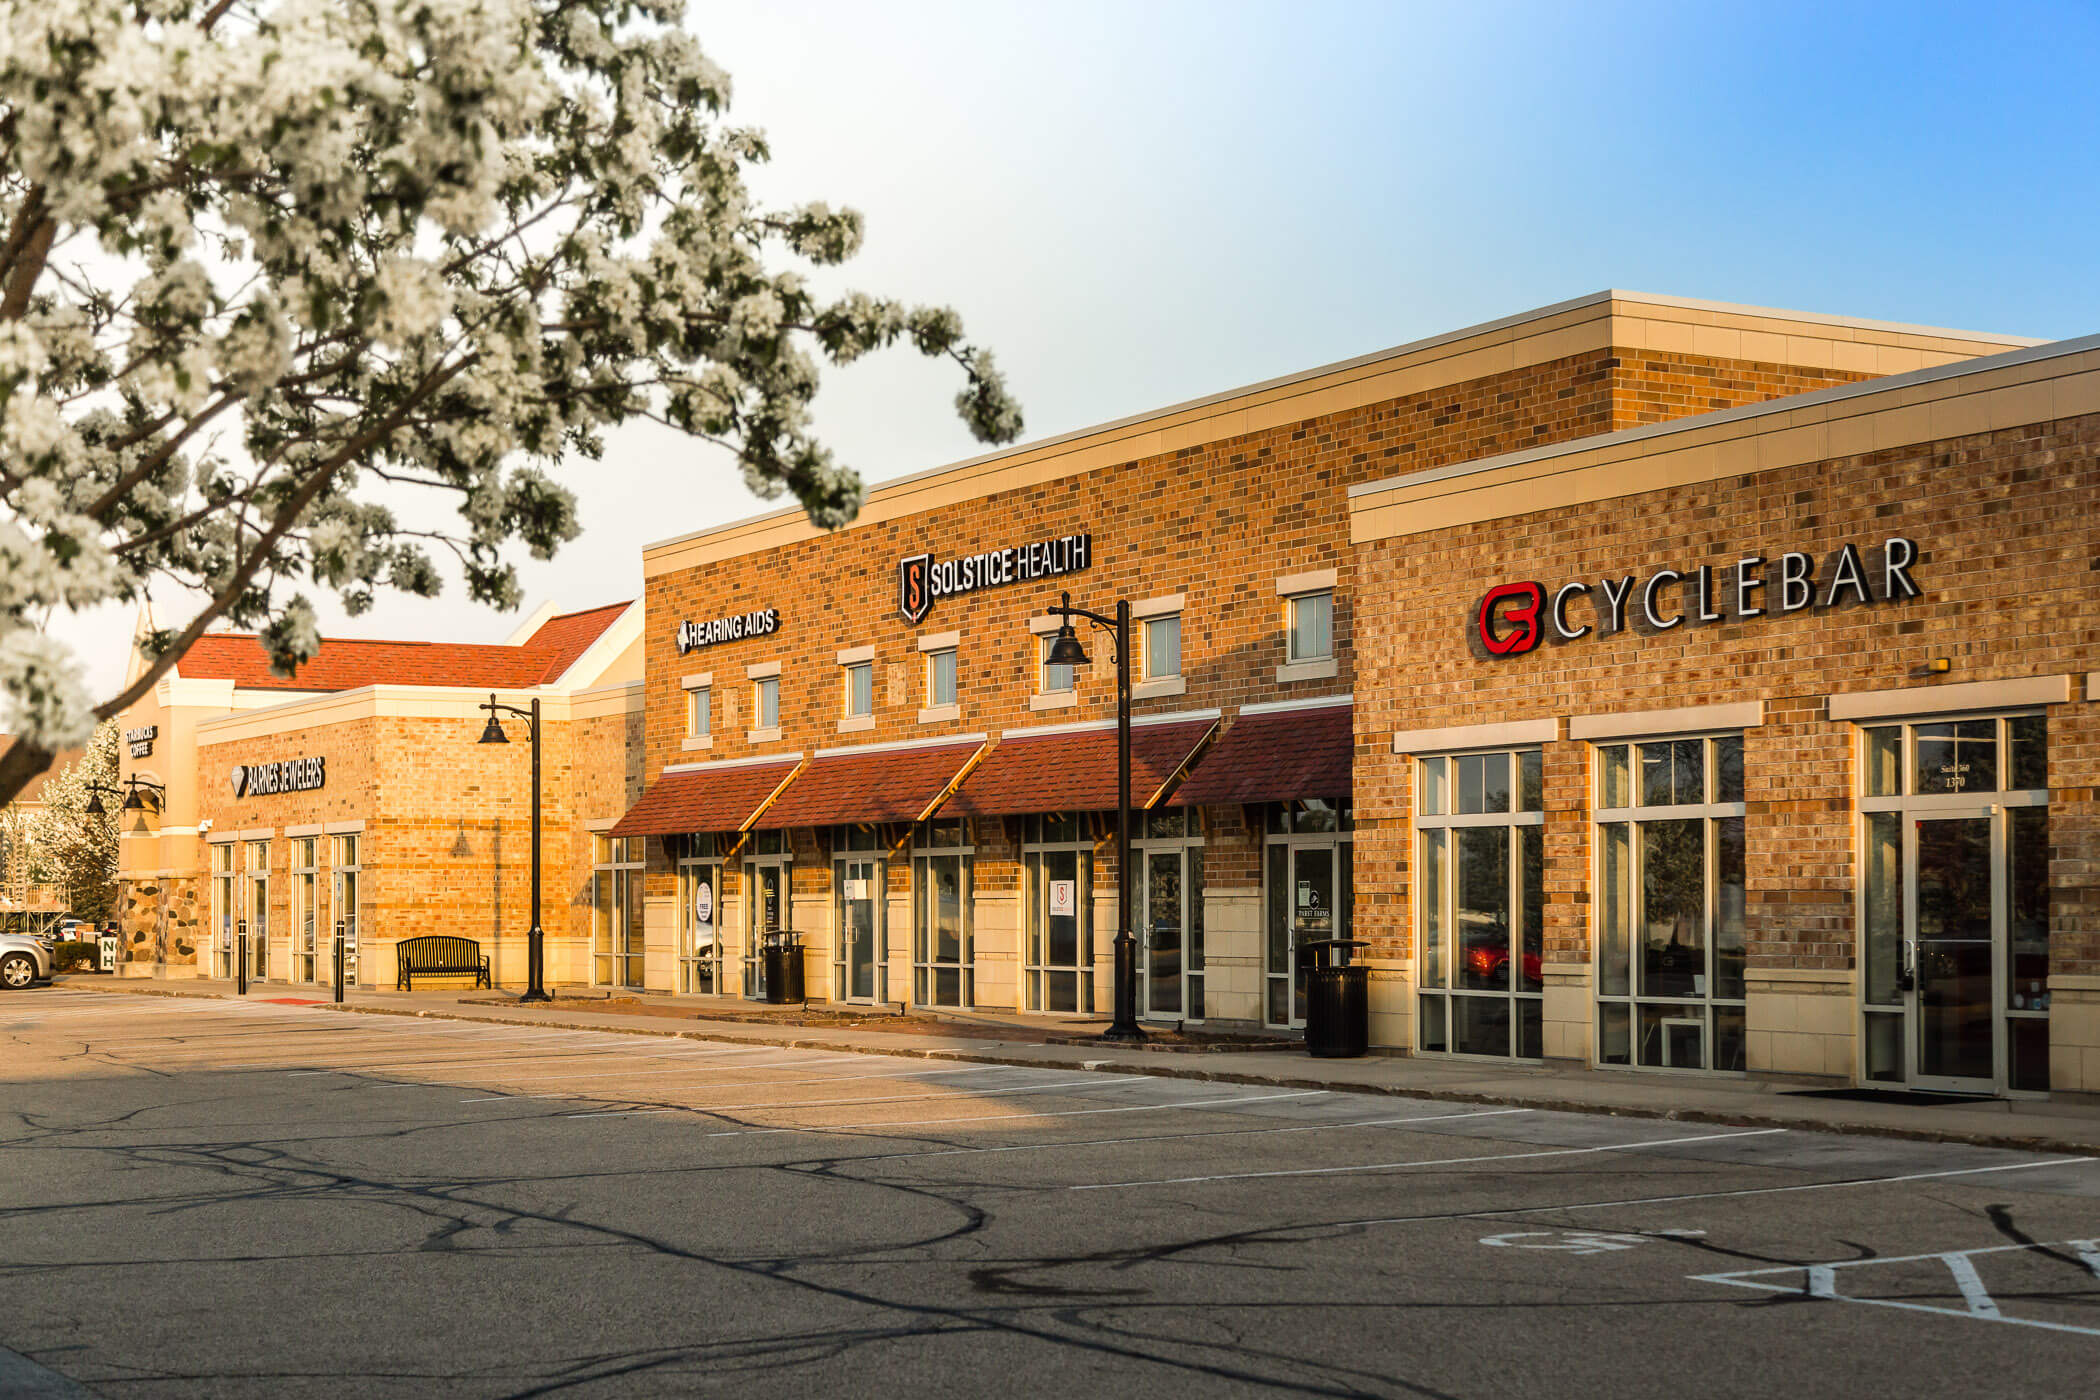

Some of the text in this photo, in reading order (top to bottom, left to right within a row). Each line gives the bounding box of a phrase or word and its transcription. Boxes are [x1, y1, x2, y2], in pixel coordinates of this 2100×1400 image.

[930, 534, 1088, 597] SOLSTICE HEALTH
[909, 564, 920, 609] S
[1553, 537, 1920, 639] CYCLEBAR
[688, 609, 777, 647] HEARING AIDS
[126, 725, 155, 743] STARBUCKS
[130, 742, 152, 758] COFFEE
[248, 757, 324, 796] BARNES JEWELERS
